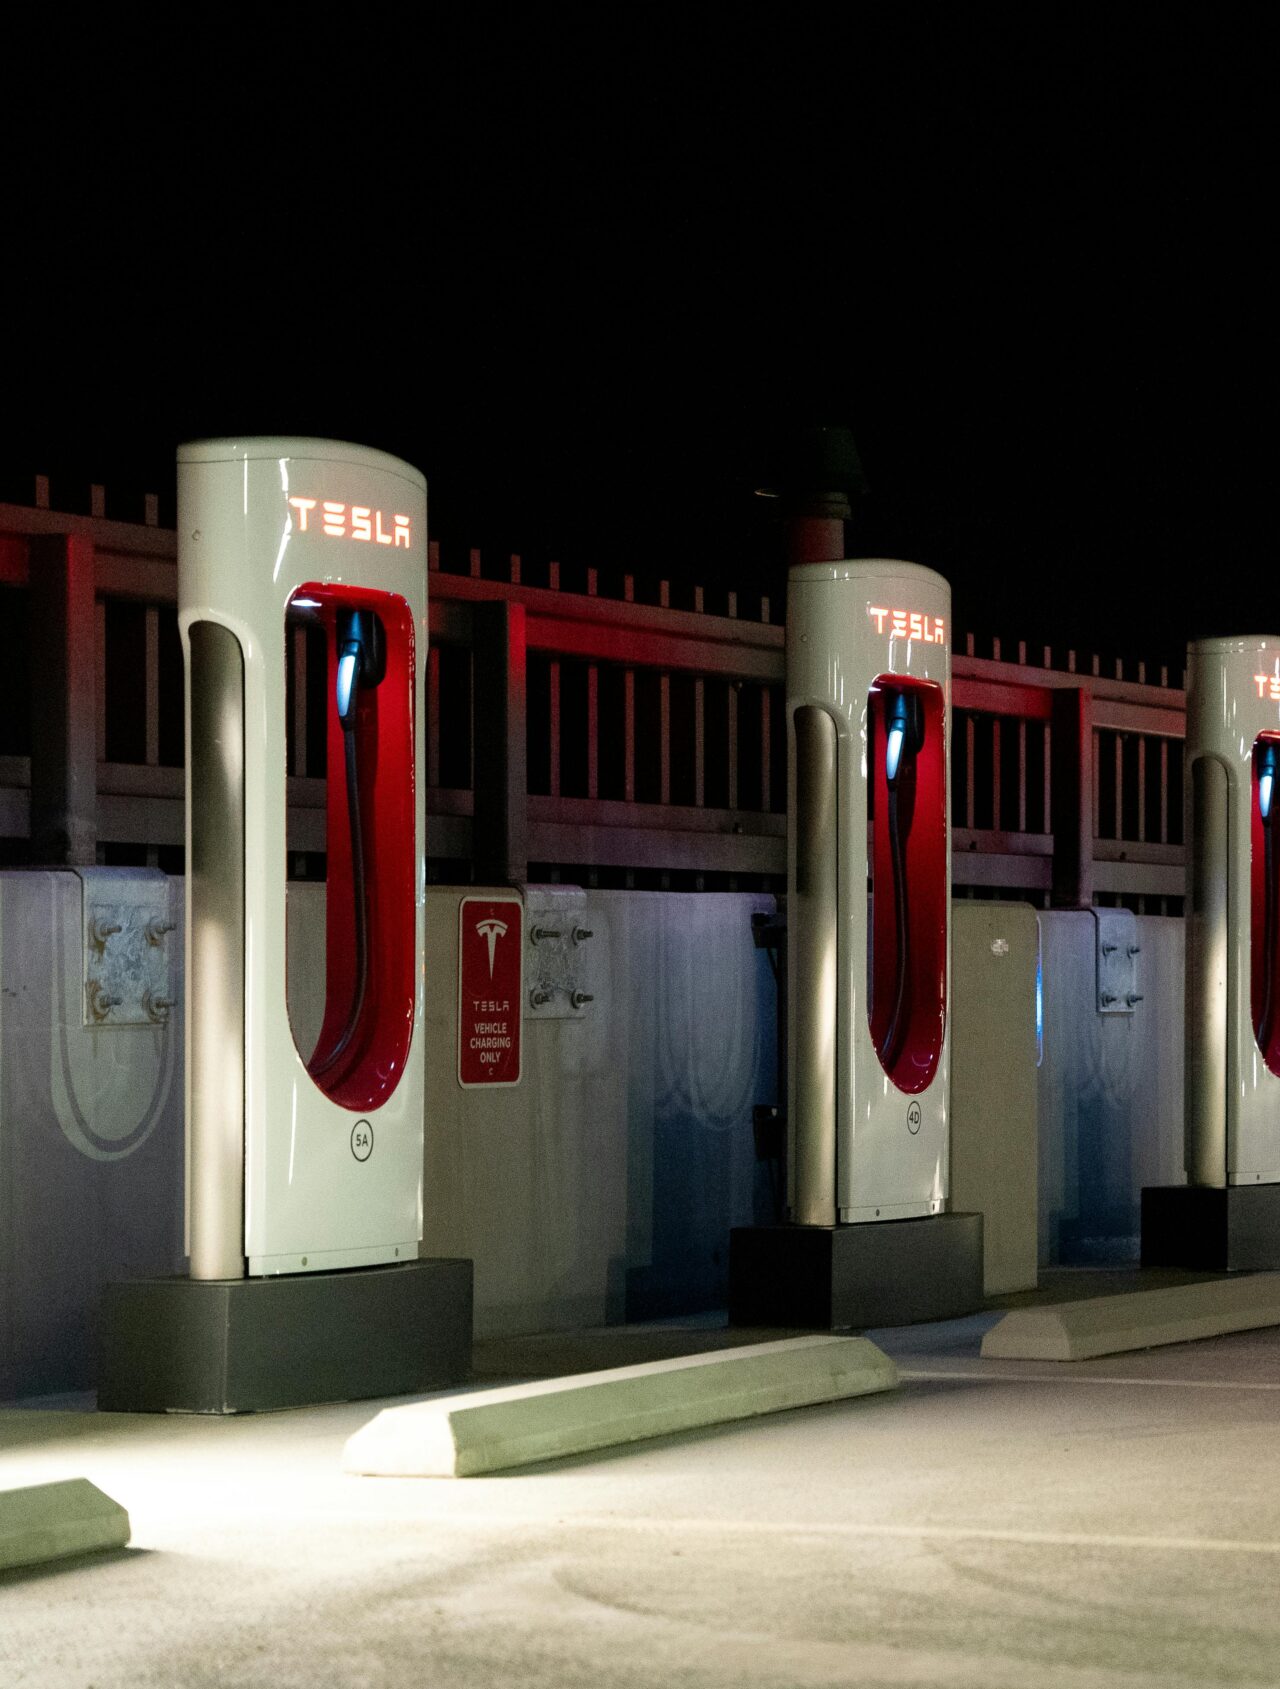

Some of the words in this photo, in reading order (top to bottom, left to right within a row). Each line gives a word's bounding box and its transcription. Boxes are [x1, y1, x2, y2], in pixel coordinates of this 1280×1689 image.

[288, 496, 411, 549] TESLA
[869, 607, 944, 645] TESLA
[473, 1001, 510, 1012] TESLA
[474, 1022, 508, 1034] VEHICLE
[469, 1037, 511, 1049] CHARGING
[480, 1051, 501, 1064] ONLY
[909, 1111, 920, 1124] 4D
[356, 1133, 369, 1147] 5A
